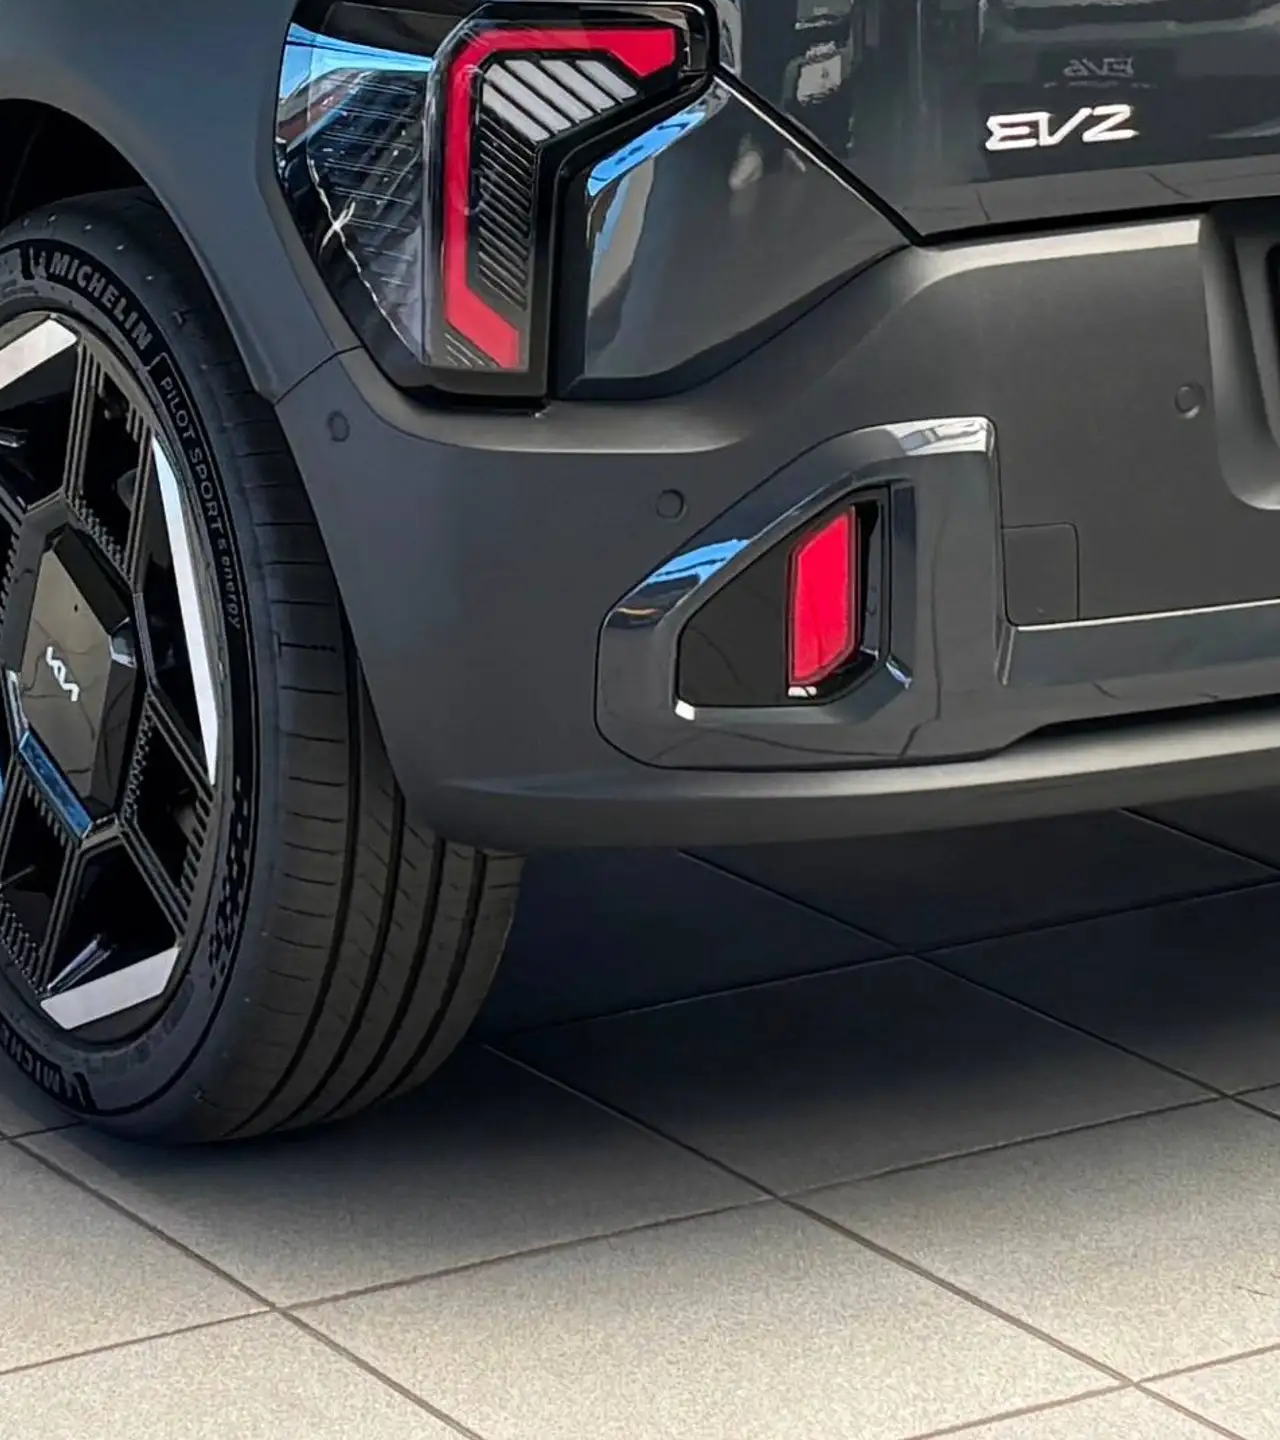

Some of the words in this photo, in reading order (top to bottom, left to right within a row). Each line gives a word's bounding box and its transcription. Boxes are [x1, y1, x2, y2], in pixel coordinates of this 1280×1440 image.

[985, 104, 1139, 151] EV2
[49, 251, 153, 350] MICHELIN
[160, 376, 195, 440] PILOT
[190, 446, 224, 536] SPORT
